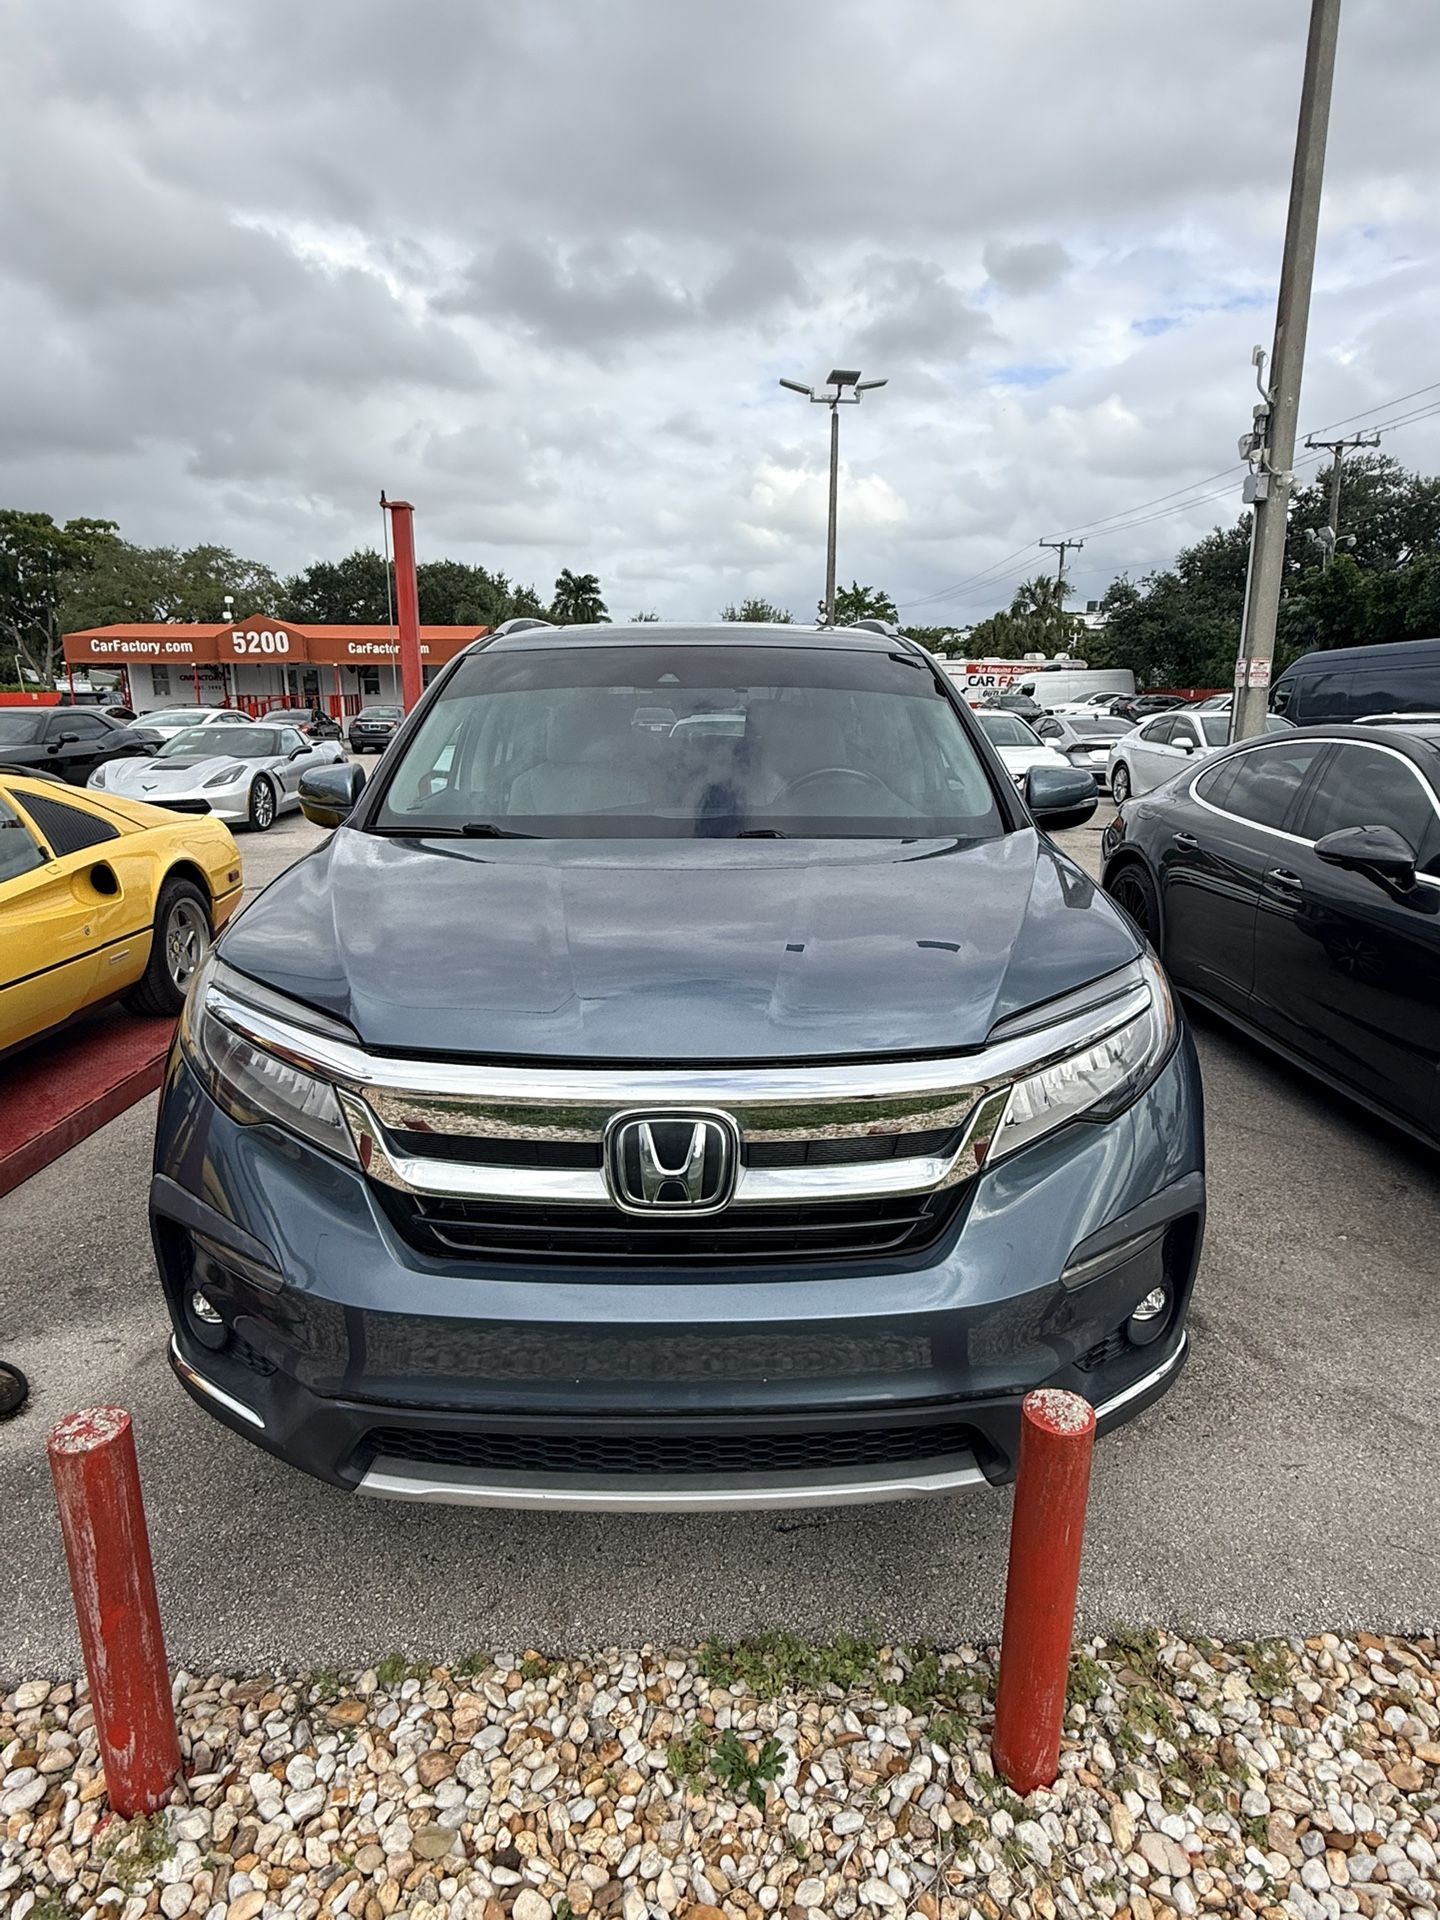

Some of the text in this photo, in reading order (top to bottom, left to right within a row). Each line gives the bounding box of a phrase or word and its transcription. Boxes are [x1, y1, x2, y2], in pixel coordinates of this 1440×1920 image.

[91, 639, 193, 655] CarFactory.com
[232, 631, 289, 653] 5200
[348, 642, 430, 654] CarFactorm
[968, 676, 1015, 688] CAR FA
